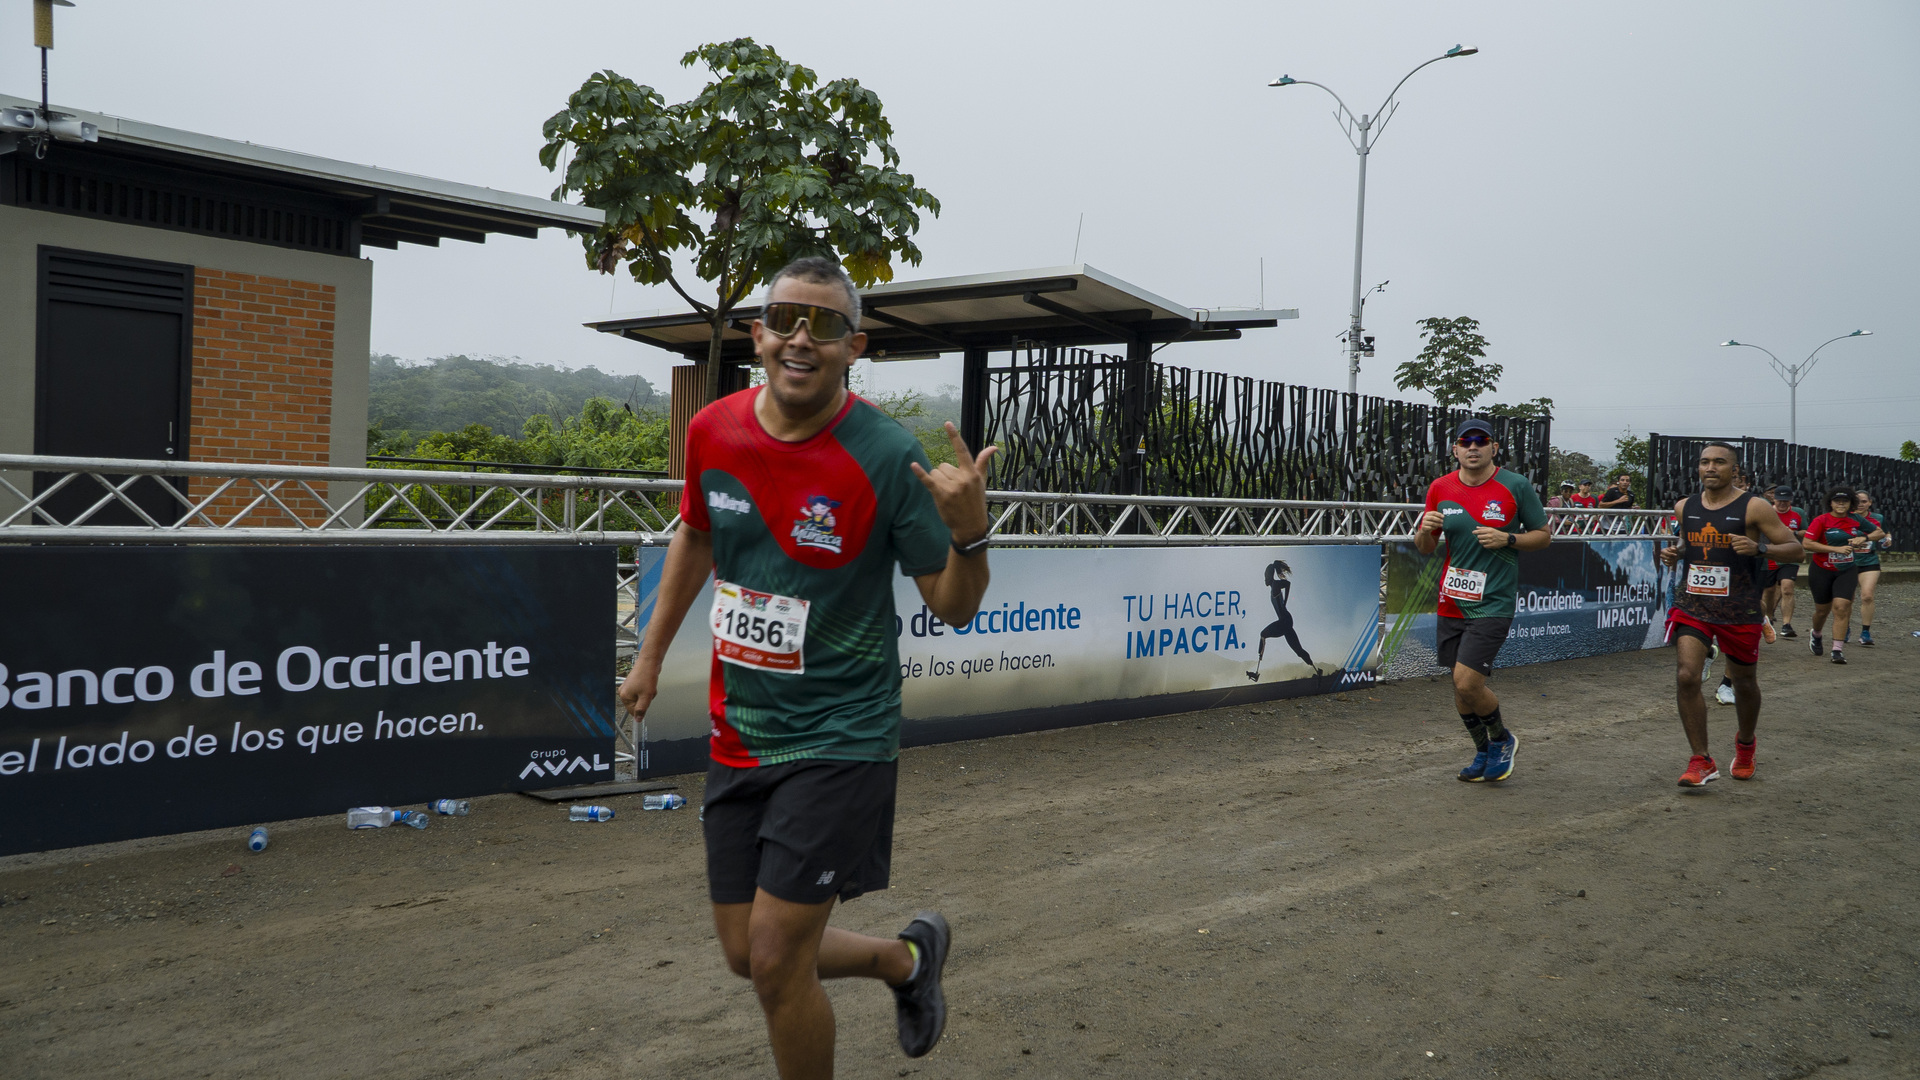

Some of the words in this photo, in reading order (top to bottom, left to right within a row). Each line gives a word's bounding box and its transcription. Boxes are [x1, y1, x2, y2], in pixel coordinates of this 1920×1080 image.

[1687, 531, 1731, 544] UNITED
[1448, 576, 1476, 591] 2080
[1692, 574, 1716, 586] 329
[1527, 590, 1583, 612] Occidente
[1596, 586, 1611, 604] TU
[1613, 584, 1652, 603] HACER,
[1123, 594, 1153, 622] TU
[1164, 590, 1246, 620] HACER,
[725, 608, 785, 648] 1856
[910, 604, 945, 638] de
[1597, 607, 1651, 628] IMPACTA.
[1126, 623, 1246, 659] IMPACTA.
[1516, 623, 1529, 638] los
[1530, 625, 1546, 640] que
[1546, 621, 1571, 636] hacen.
[0, 662, 175, 710] anco
[189, 649, 262, 698] de
[276, 640, 530, 692] Occidente
[900, 656, 923, 679] de
[928, 655, 955, 676] los
[960, 657, 994, 679] que
[999, 650, 1055, 672] hacen.
[1340, 670, 1374, 685] AVAL
[54, 731, 155, 770] lado
[166, 725, 218, 759] de
[230, 721, 285, 753] los
[296, 721, 364, 754] que
[374, 710, 484, 740] hacen.
[530, 748, 567, 760] Grupo
[518, 753, 610, 780] AVAL
